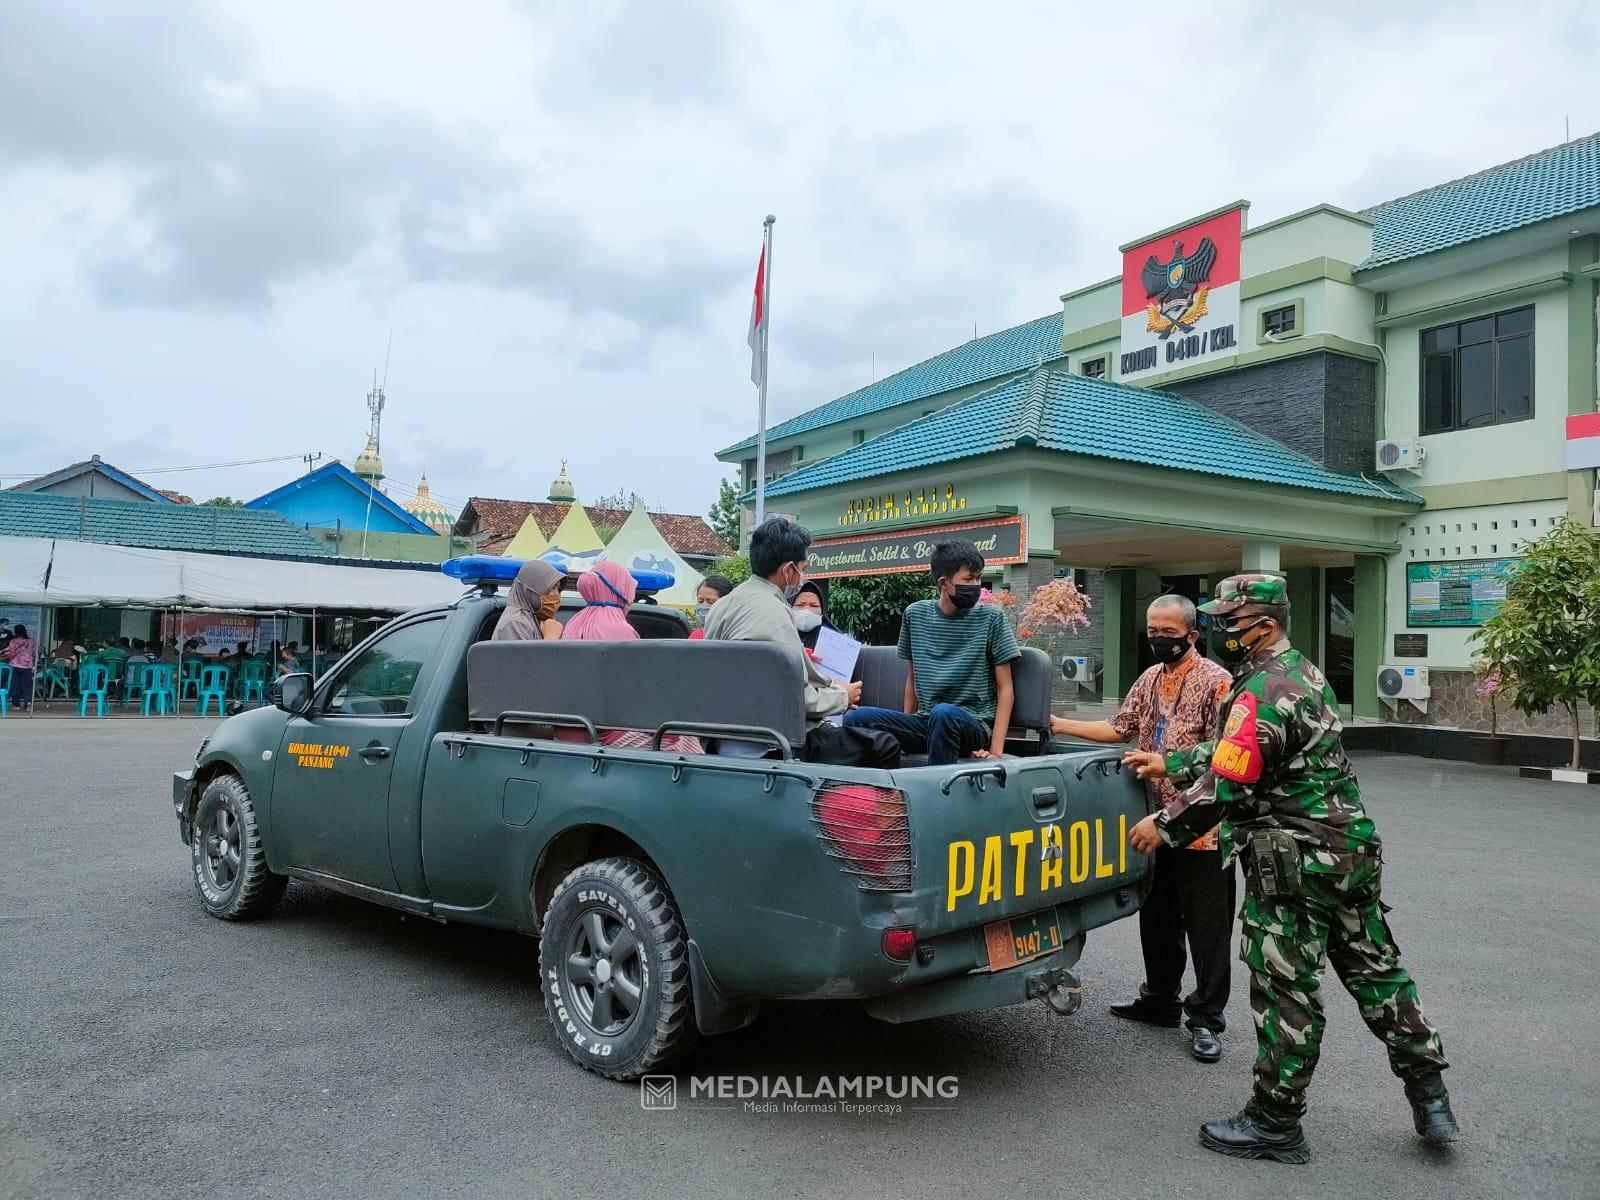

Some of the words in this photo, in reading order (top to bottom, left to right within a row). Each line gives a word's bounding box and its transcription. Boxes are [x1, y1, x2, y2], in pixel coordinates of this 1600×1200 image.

[1120, 345, 1157, 375] KODIM
[838, 513, 860, 526] KOTA
[863, 507, 901, 522] BANDAR
[905, 497, 966, 517] LAMPUNG
[847, 493, 895, 514] KODIM
[904, 483, 953, 506] 0410
[869, 545, 900, 562] Solid
[900, 546, 910, 559] &
[288, 742, 323, 755] KORAMIL
[323, 744, 350, 757] 410-01
[946, 814, 1126, 912] PATROLI
[577, 889, 636, 931] SAVERO
[549, 965, 587, 1047] RADIAL
[589, 1044, 612, 1057] GT
